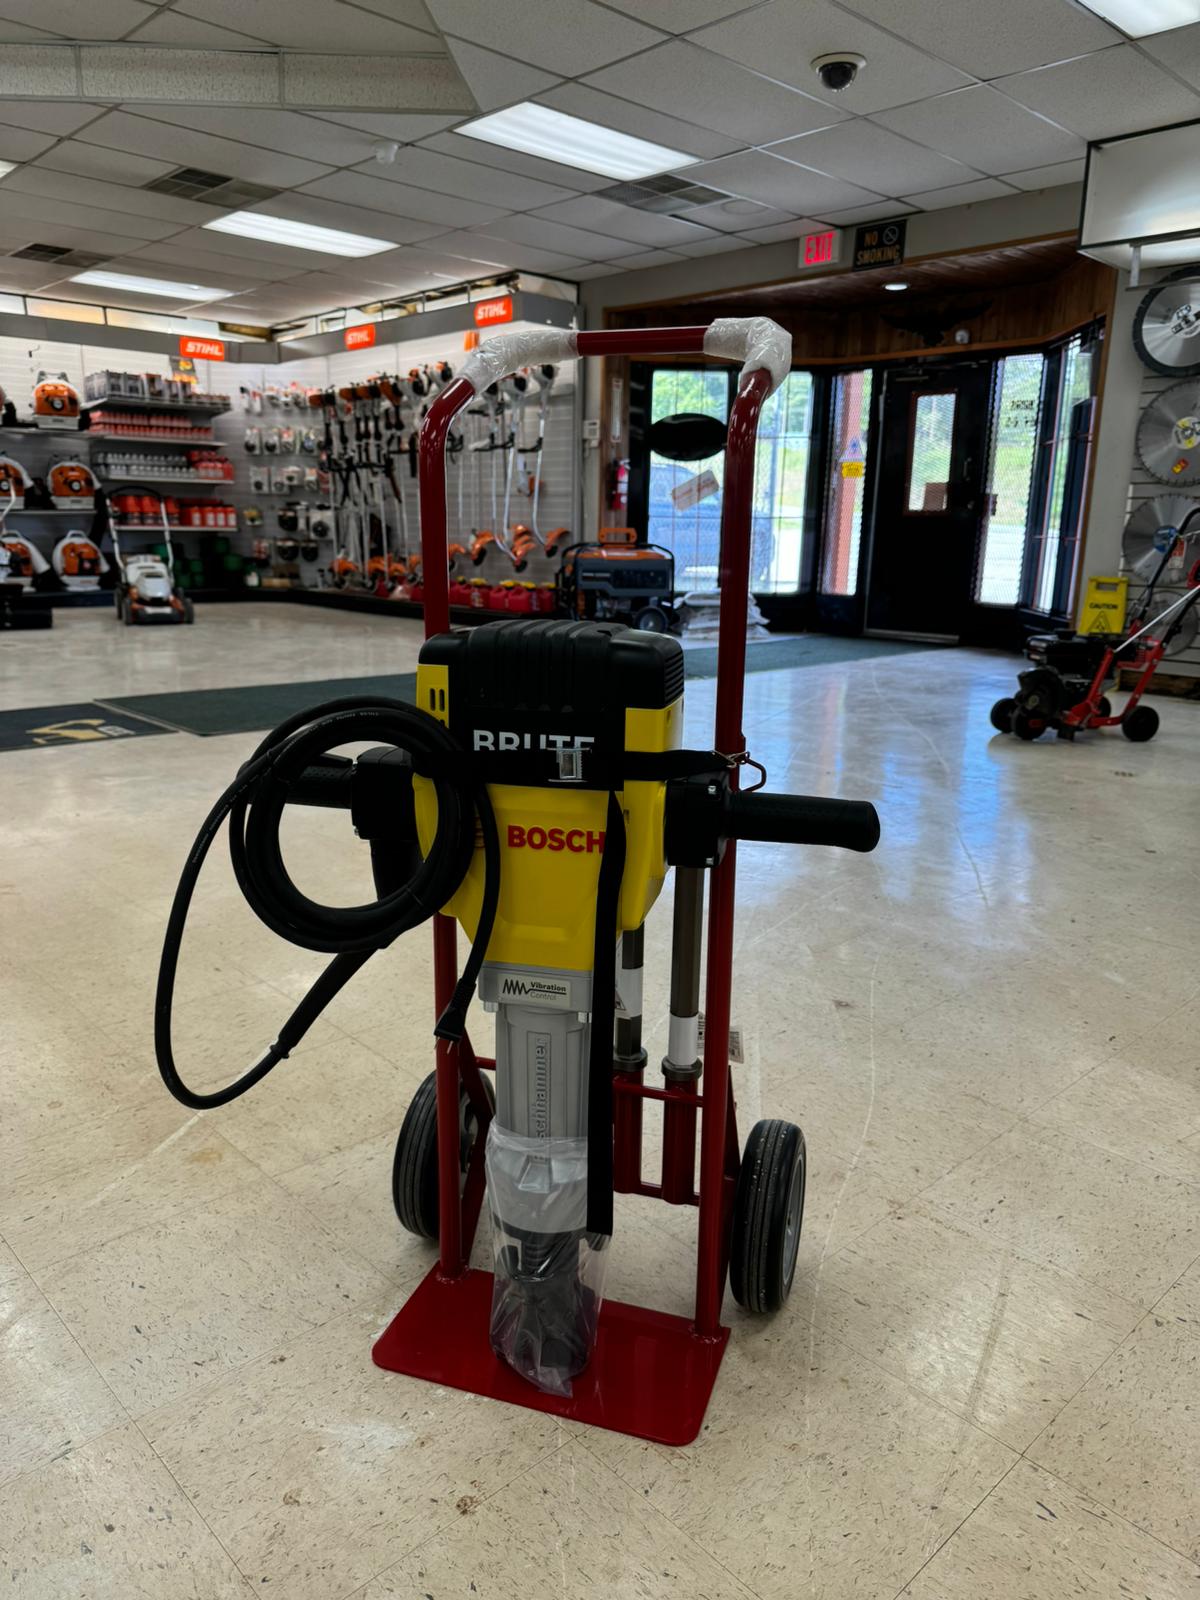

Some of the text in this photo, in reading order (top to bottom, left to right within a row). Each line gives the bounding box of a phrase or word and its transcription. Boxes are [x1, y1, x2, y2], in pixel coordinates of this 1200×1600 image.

[864, 230, 879, 247] NO
[804, 231, 834, 266] EXIT
[856, 244, 901, 266] SMOKING
[476, 302, 507, 320] STIHL
[346, 330, 370, 345] STIHL
[185, 340, 223, 357] STIHL
[1089, 602, 1118, 610] CAUTION
[507, 824, 606, 854] BOSCH
[530, 981, 567, 992] Vibration
[530, 992, 557, 1001] Control
